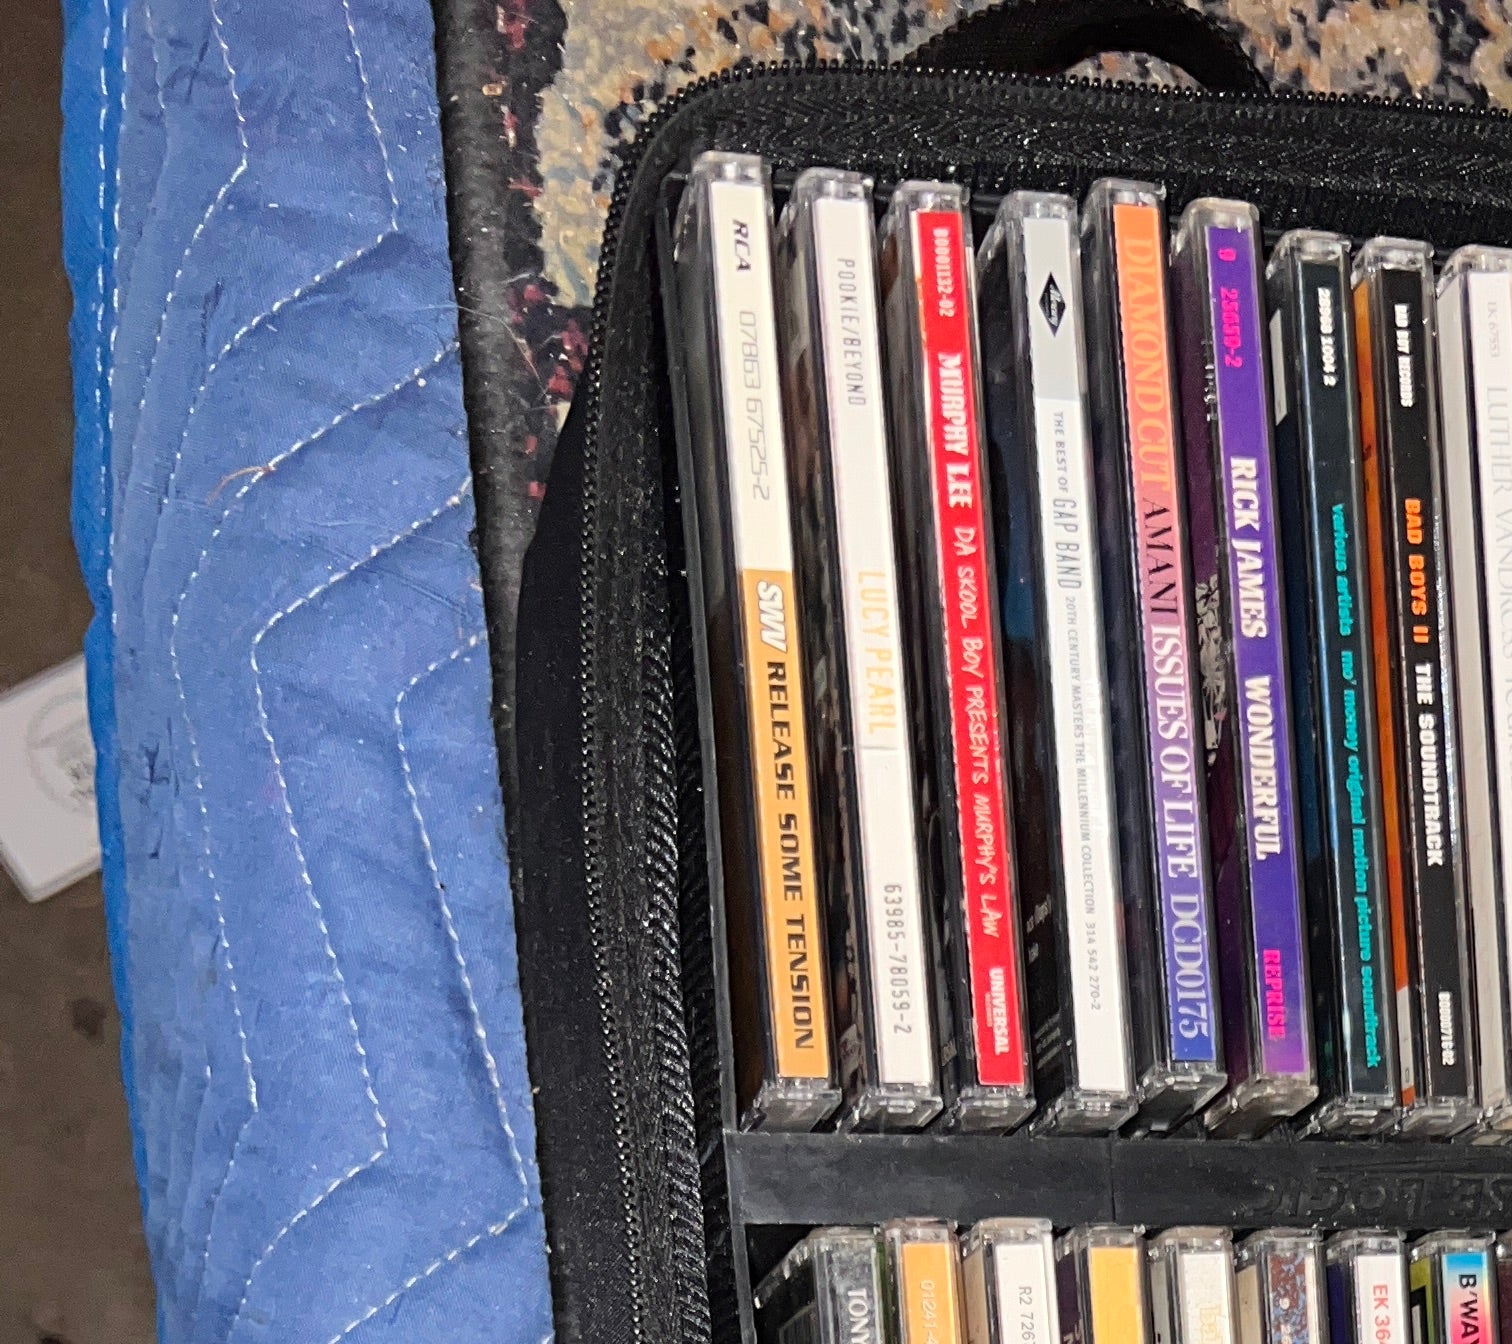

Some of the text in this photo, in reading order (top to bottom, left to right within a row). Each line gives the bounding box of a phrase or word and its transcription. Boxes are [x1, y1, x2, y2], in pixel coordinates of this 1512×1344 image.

[733, 219, 752, 271] RCA
[837, 257, 868, 405] POOKIE/BEYOND
[858, 570, 898, 734] LUCY PEARL
[938, 352, 1003, 937] MURPHY LEE DA SKOOL BOY PRESENTS MURPHY'S LAW
[1230, 456, 1282, 860] RICK JAMES WONDERFUL
[1405, 497, 1444, 866] BAD BOYS II THE SOUNDTRACK
[767, 660, 796, 799] RELEASE
[1142, 497, 1207, 1040] AMANI ISSUES OF LIFE DCD0175
[778, 812, 804, 901] SOME
[786, 913, 815, 1048] TENSION
[883, 883, 913, 1034] 63985-78059-2
[990, 967, 1007, 1055] UNIVERSAL
